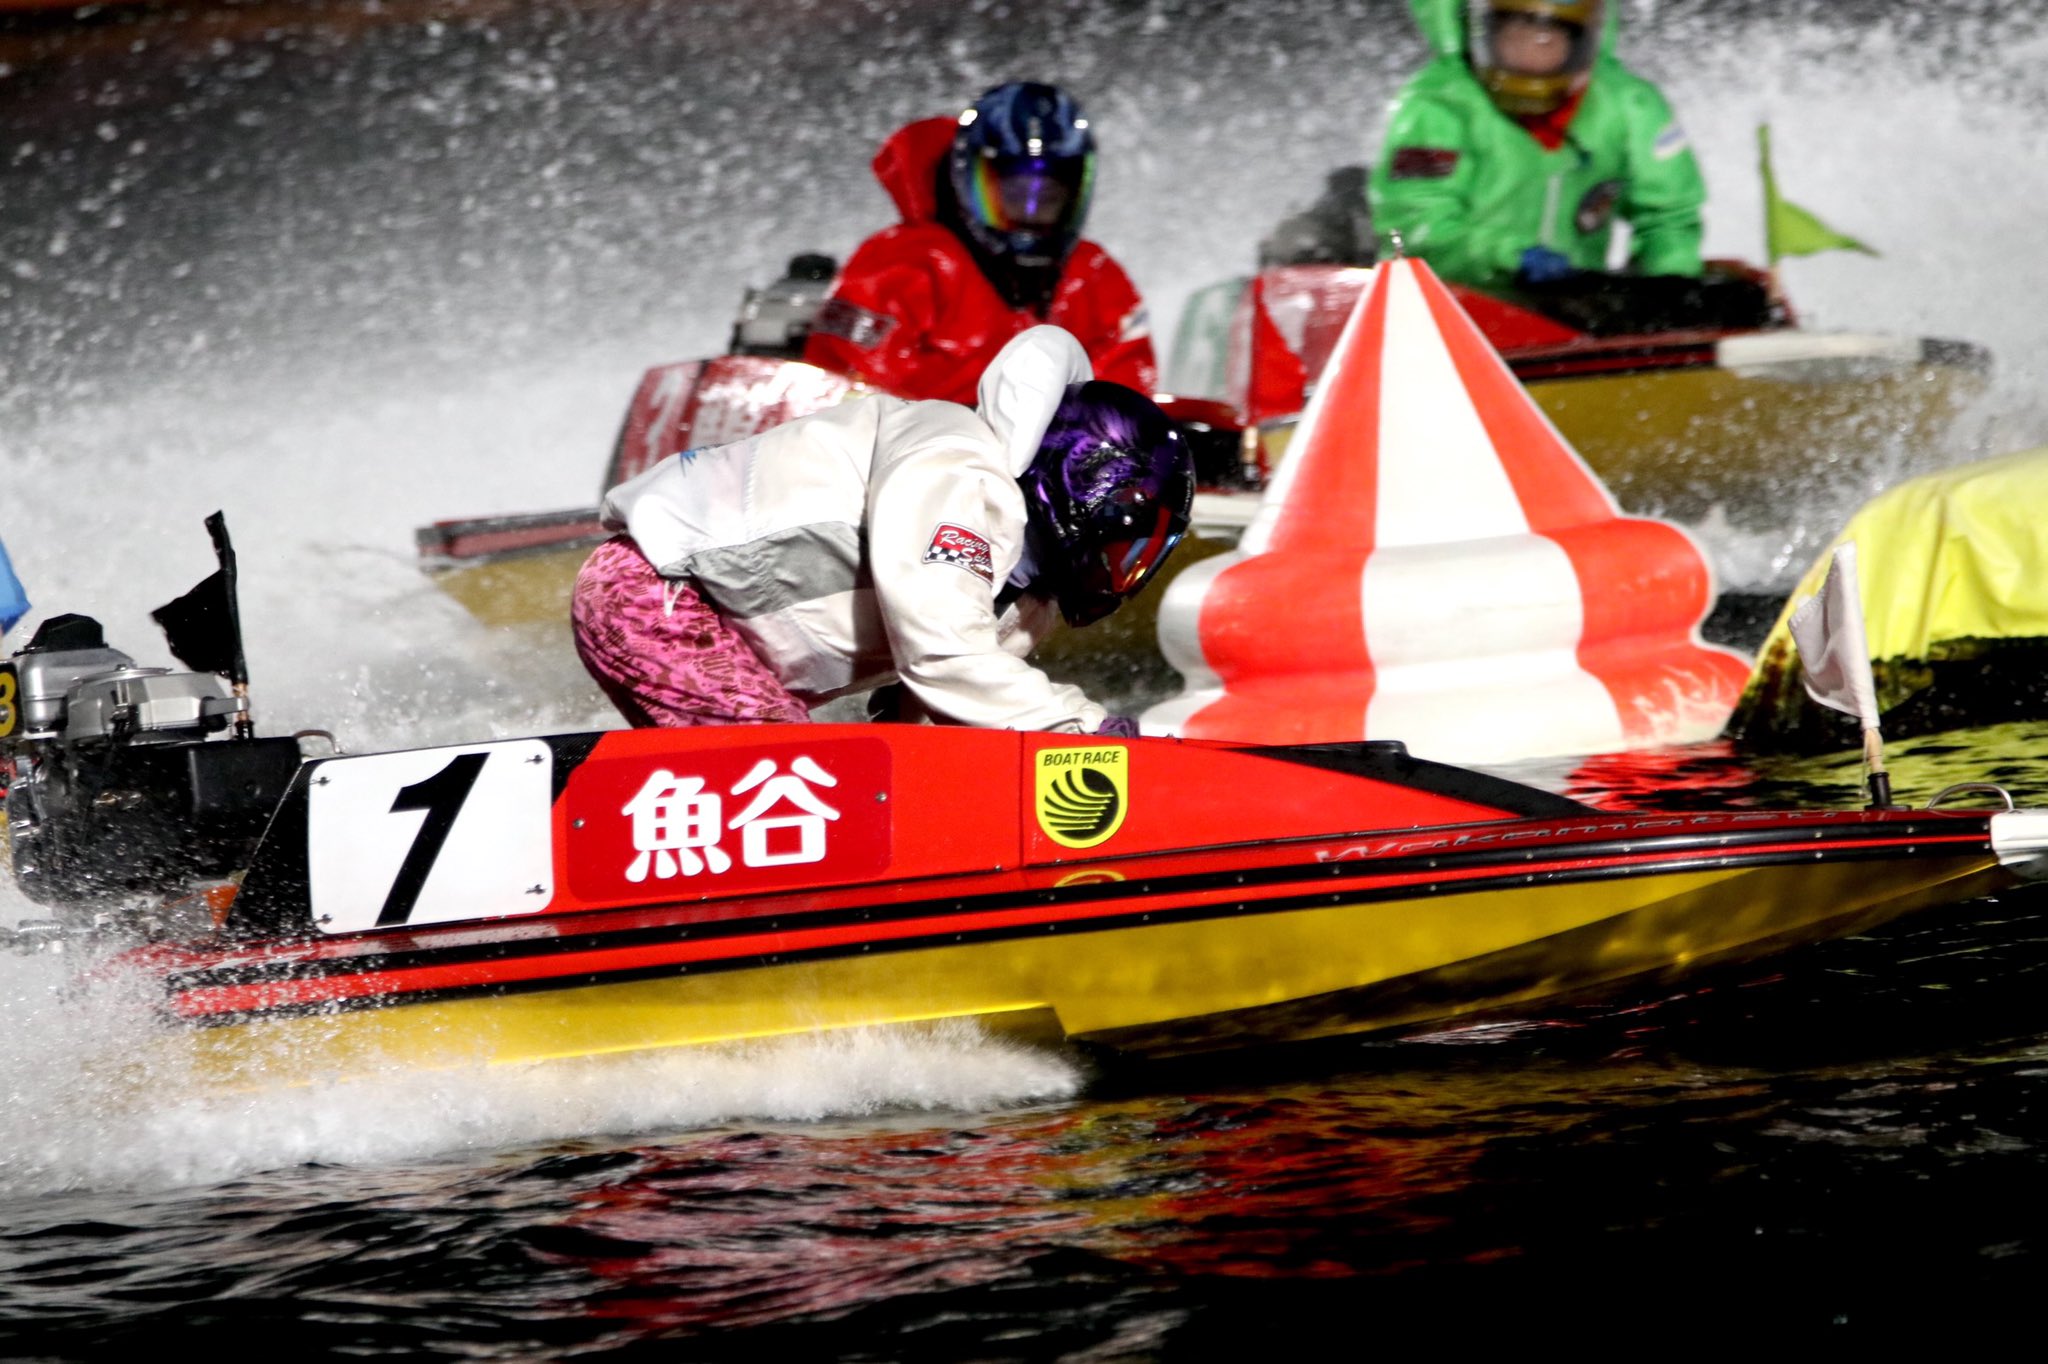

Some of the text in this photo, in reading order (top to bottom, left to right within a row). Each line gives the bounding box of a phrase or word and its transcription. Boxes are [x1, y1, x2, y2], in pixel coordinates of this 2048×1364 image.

[940, 530, 989, 555] Racing
[1043, 751, 1120, 767] BOAT RACE
[375, 752, 491, 927] 1
[622, 756, 840, 882] 魚谷
